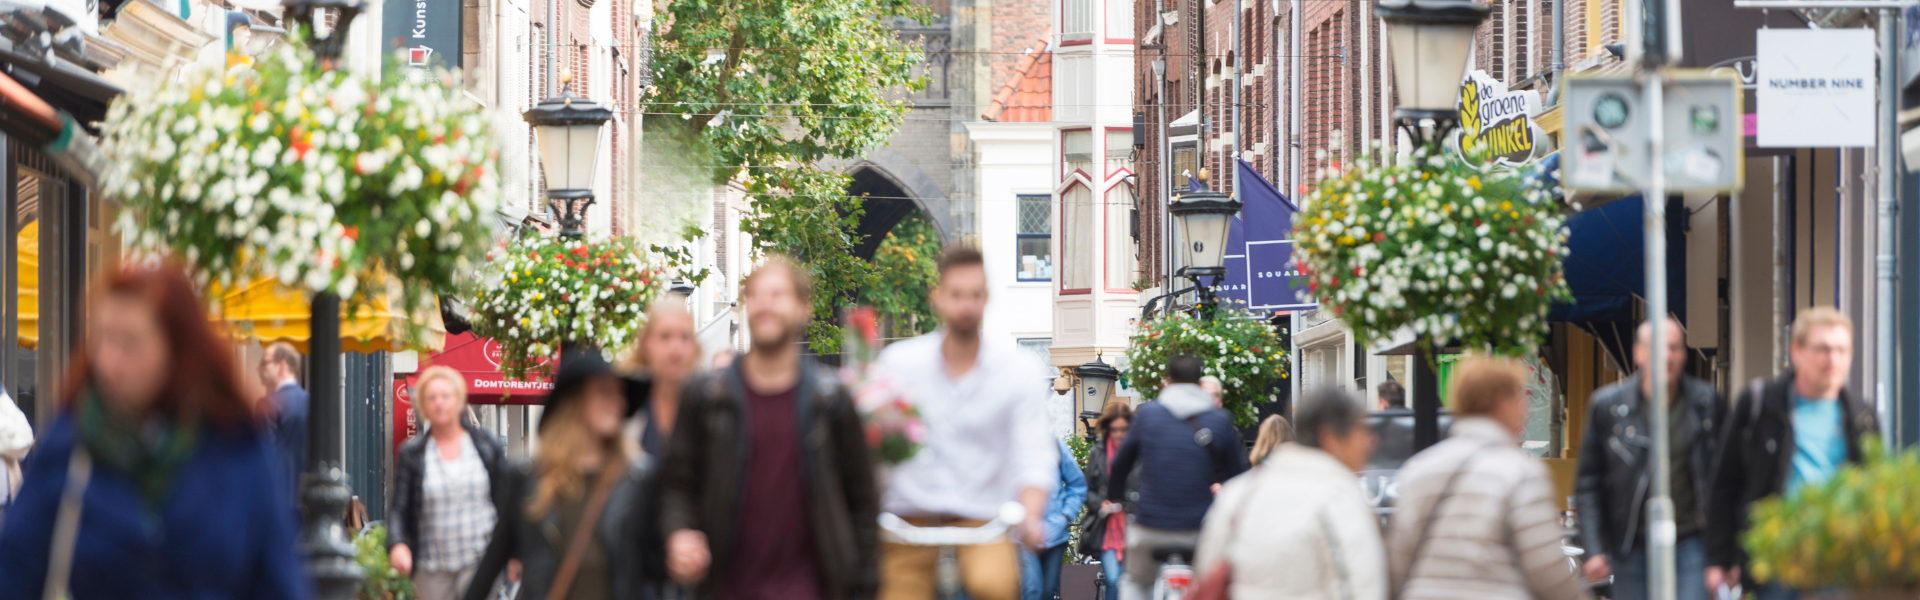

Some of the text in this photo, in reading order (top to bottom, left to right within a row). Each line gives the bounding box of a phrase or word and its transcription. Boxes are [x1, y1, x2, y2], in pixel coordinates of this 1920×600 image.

[412, 0, 427, 38] Kuns
[1480, 82, 1493, 100] de
[1769, 78, 1863, 88] NUMBER NINE
[1482, 95, 1526, 126] groene
[1258, 269, 1307, 279] SQUAR
